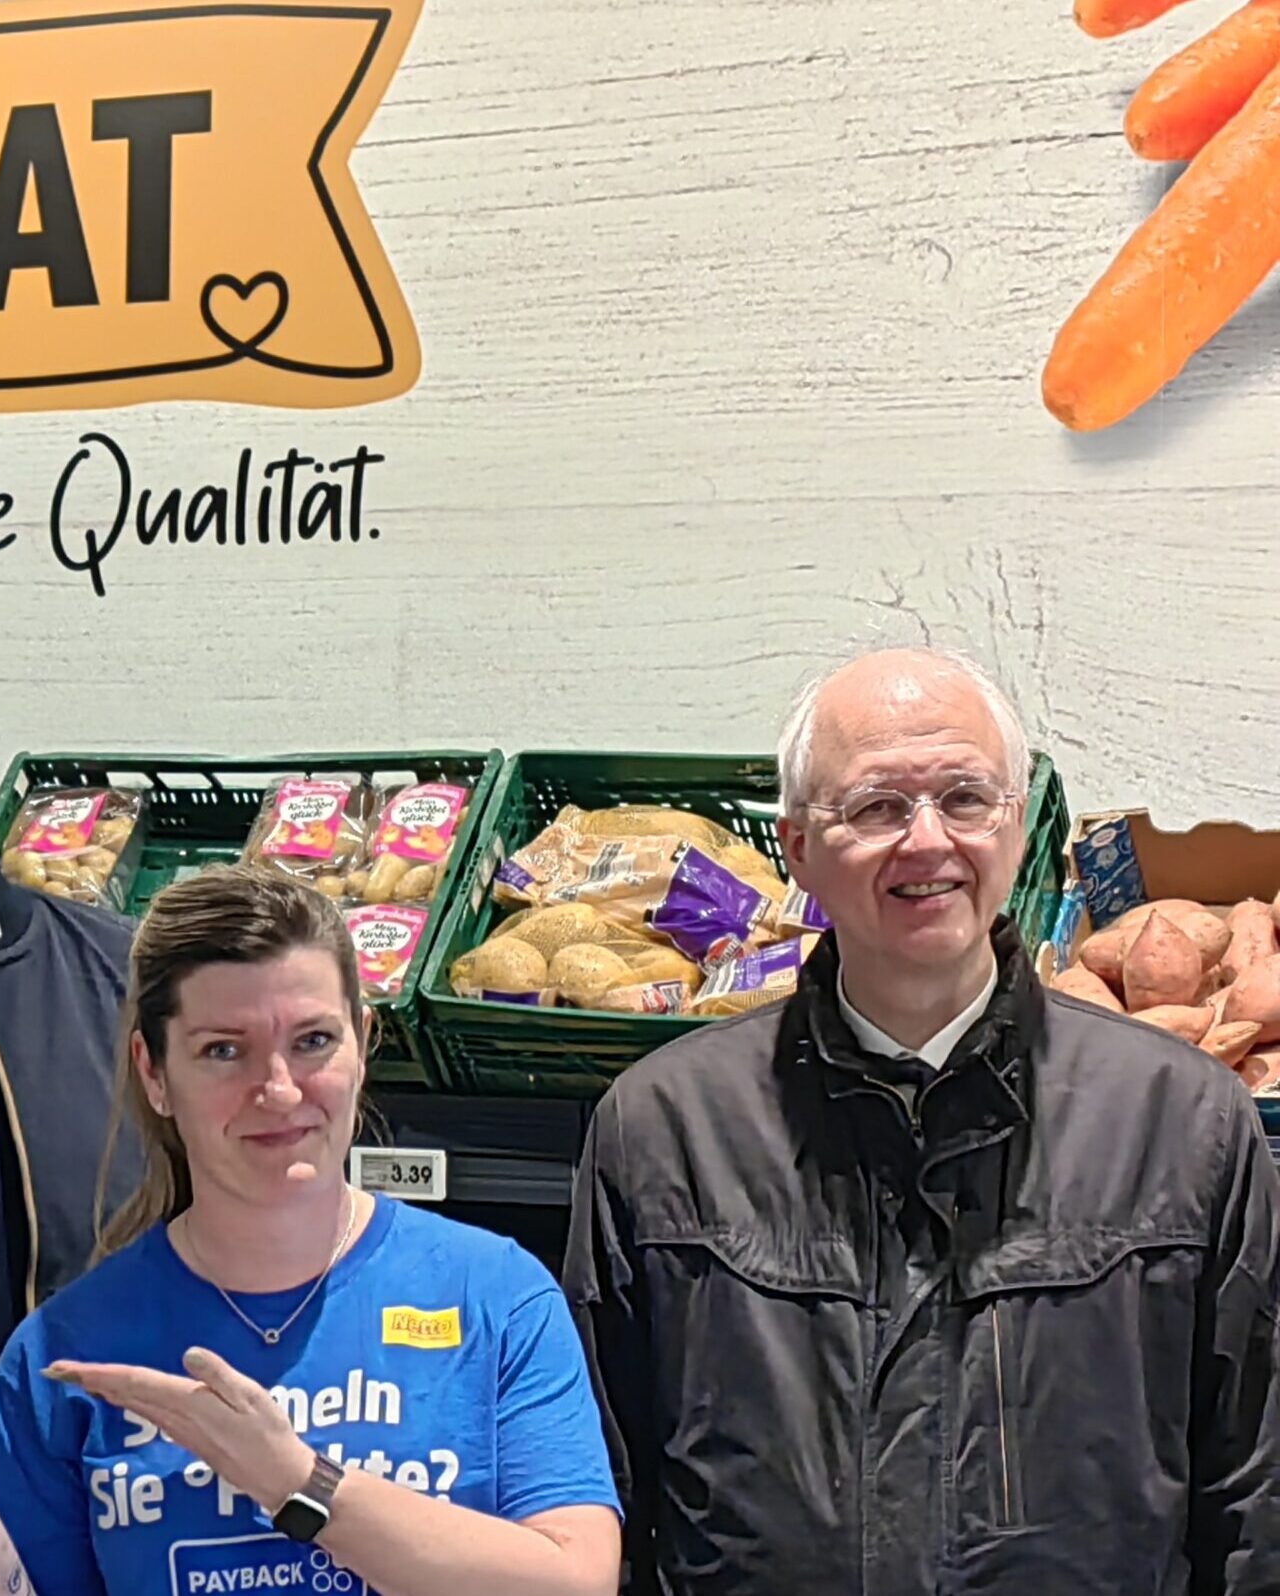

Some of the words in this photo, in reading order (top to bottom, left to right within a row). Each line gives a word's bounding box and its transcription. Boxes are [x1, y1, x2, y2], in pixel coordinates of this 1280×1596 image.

[50, 433, 385, 597] Qualität.
[391, 1163, 432, 1184] 3.39
[391, 1312, 452, 1335] Netto
[123, 1369, 402, 1448] Smeln
[91, 1461, 164, 1530] Sie
[188, 1561, 305, 1593] PAYBACK
